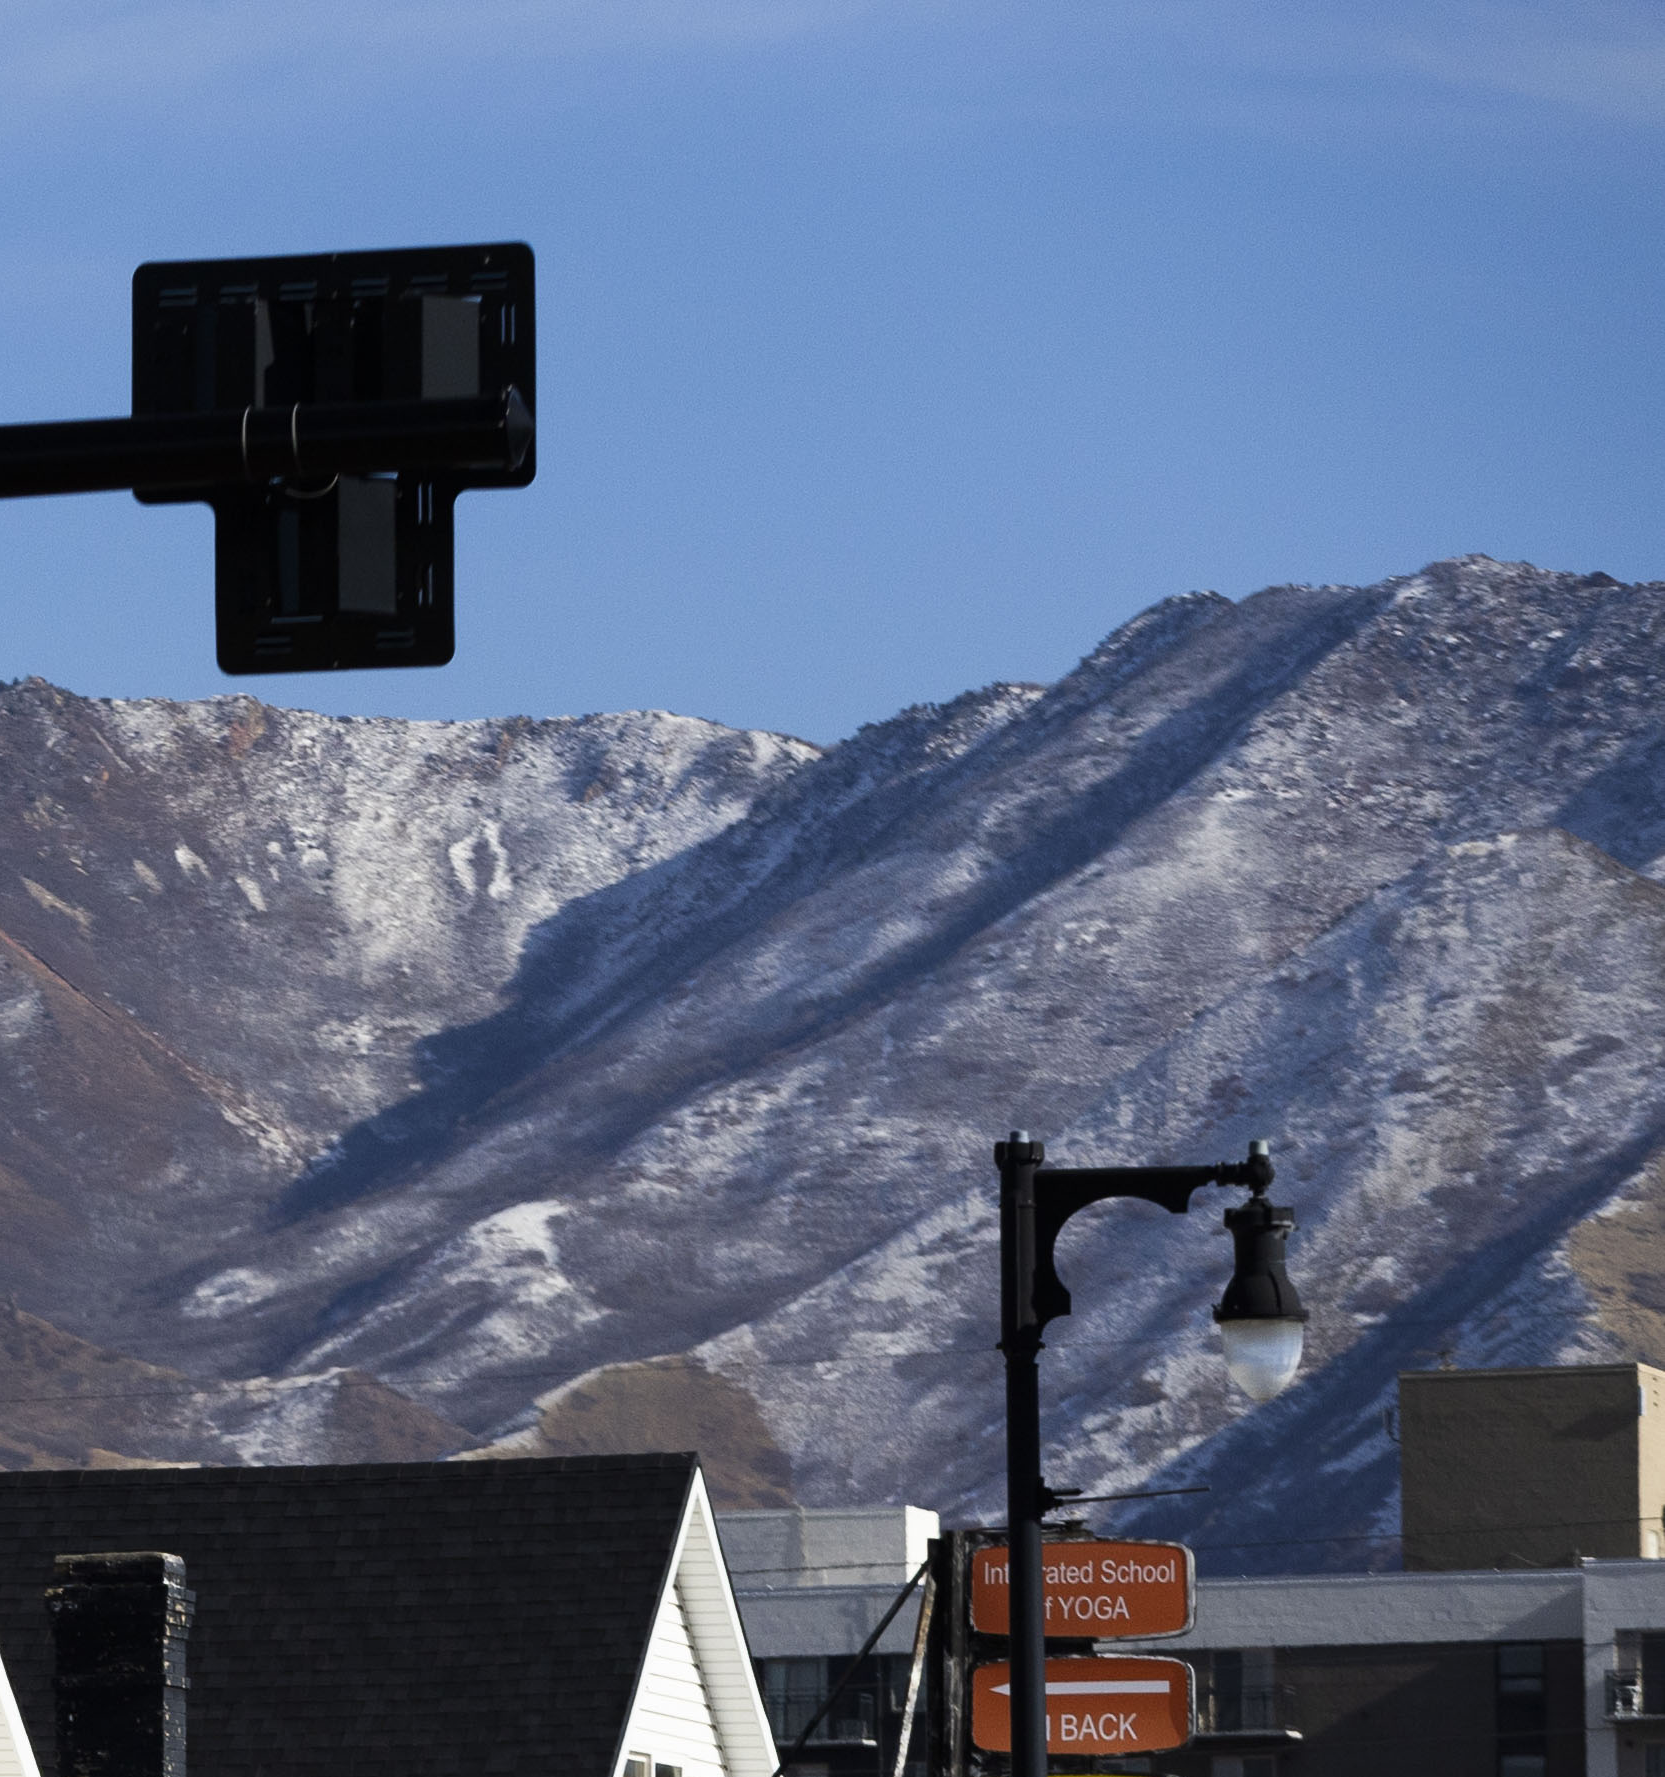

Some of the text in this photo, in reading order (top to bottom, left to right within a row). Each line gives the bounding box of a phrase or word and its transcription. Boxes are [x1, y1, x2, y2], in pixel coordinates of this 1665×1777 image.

[1101, 1559, 1175, 1585] School
[1043, 1595, 1130, 1620] f YOGA
[1061, 1713, 1138, 1742] BACK
